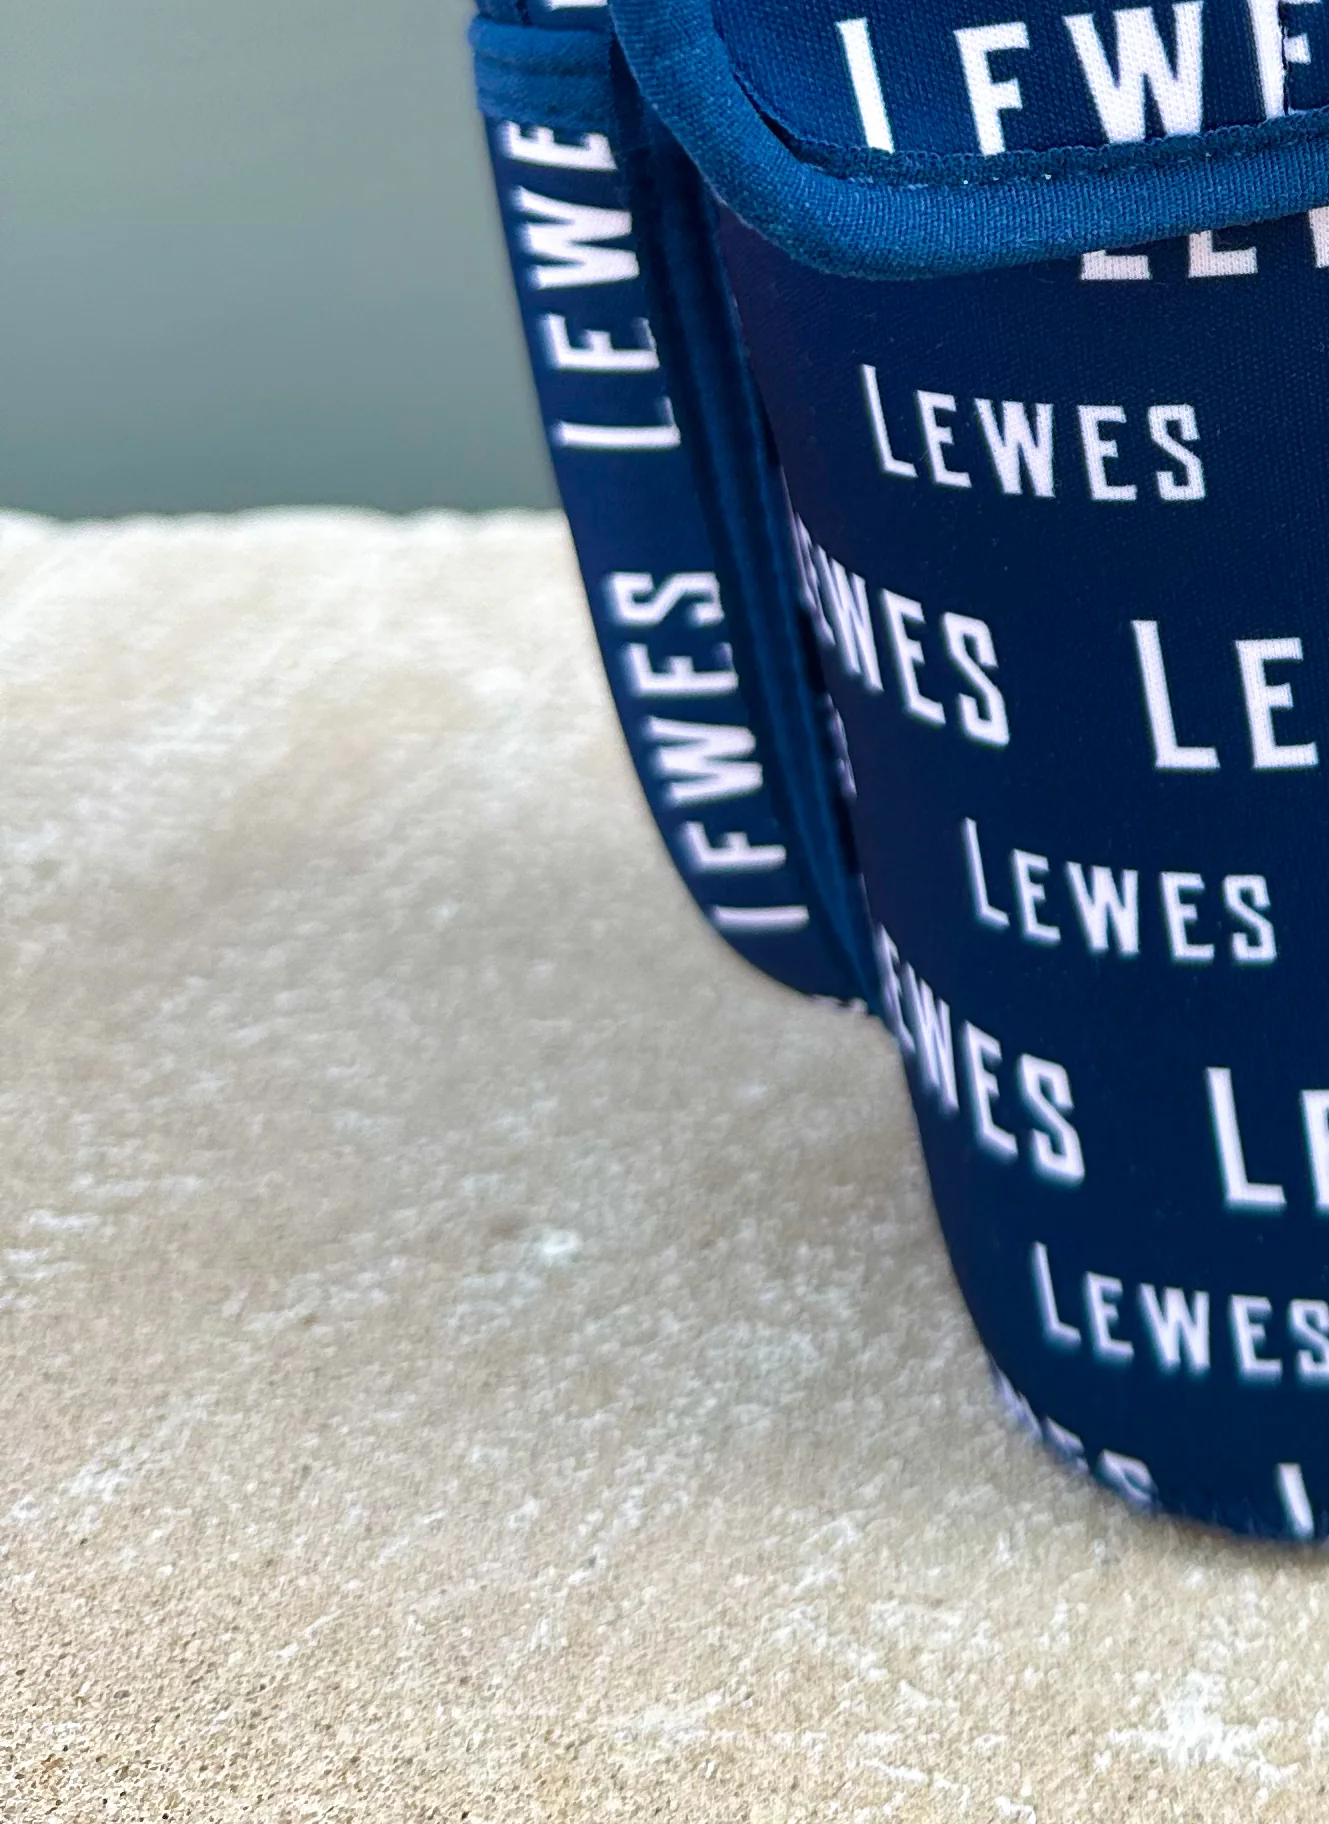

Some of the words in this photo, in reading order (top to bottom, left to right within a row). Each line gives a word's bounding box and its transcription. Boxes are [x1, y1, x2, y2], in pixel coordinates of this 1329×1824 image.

[863, 364, 1205, 500] LEWES
[788, 471, 1010, 746] EWES
[966, 819, 1276, 960] LEWES
[872, 924, 1086, 1184] EWES
